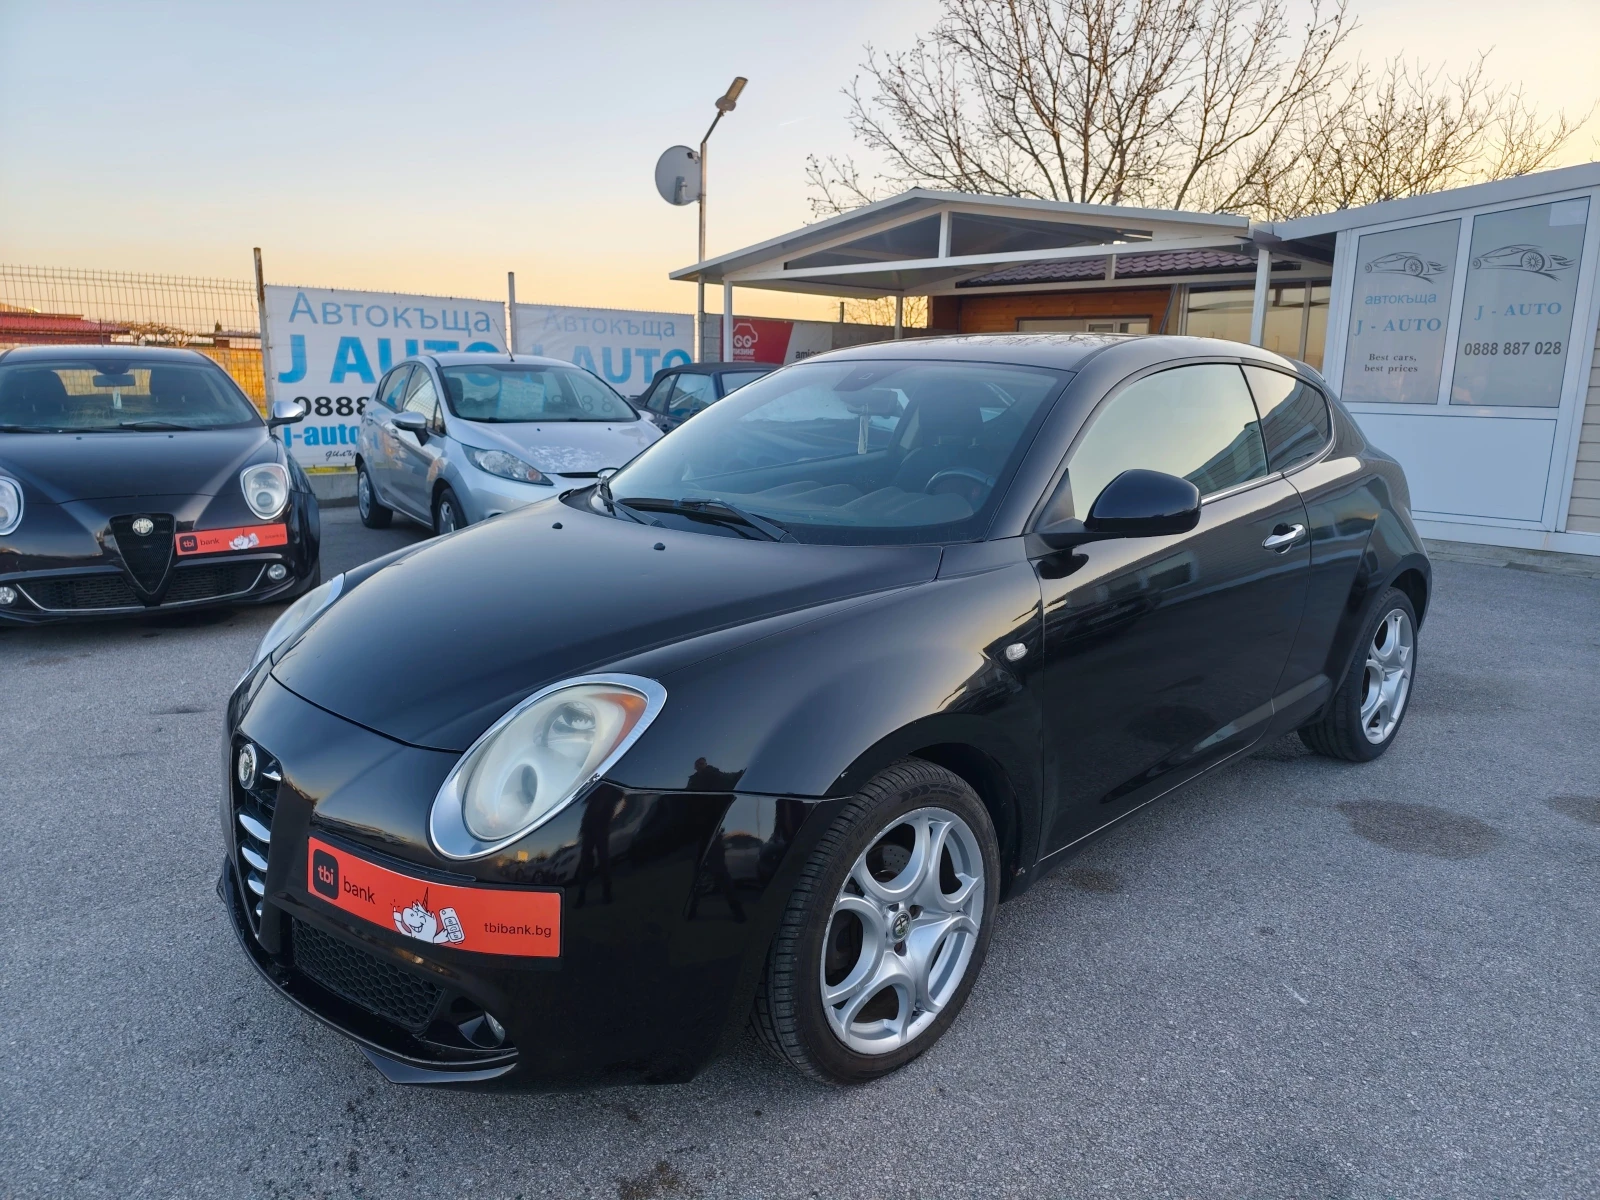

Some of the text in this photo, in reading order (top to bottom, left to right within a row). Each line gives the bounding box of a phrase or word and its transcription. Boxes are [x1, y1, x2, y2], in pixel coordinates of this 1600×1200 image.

[1364, 292, 1437, 305] автокъща
[288, 291, 491, 338] Автокъща
[1474, 304, 1484, 321] J
[1503, 302, 1562, 315] AUTO
[542, 308, 675, 341] Автокъща
[1353, 319, 1364, 337] J
[1382, 318, 1442, 332] AUTO
[795, 348, 821, 359] ami
[1463, 341, 1562, 356] 0888 887 028
[278, 333, 500, 384] J AU
[1368, 353, 1417, 363] Best cars,
[1364, 364, 1418, 374] best prices
[200, 538, 219, 546] bank
[317, 865, 376, 905] tbi bank
[483, 922, 552, 939] tbibank.bg
